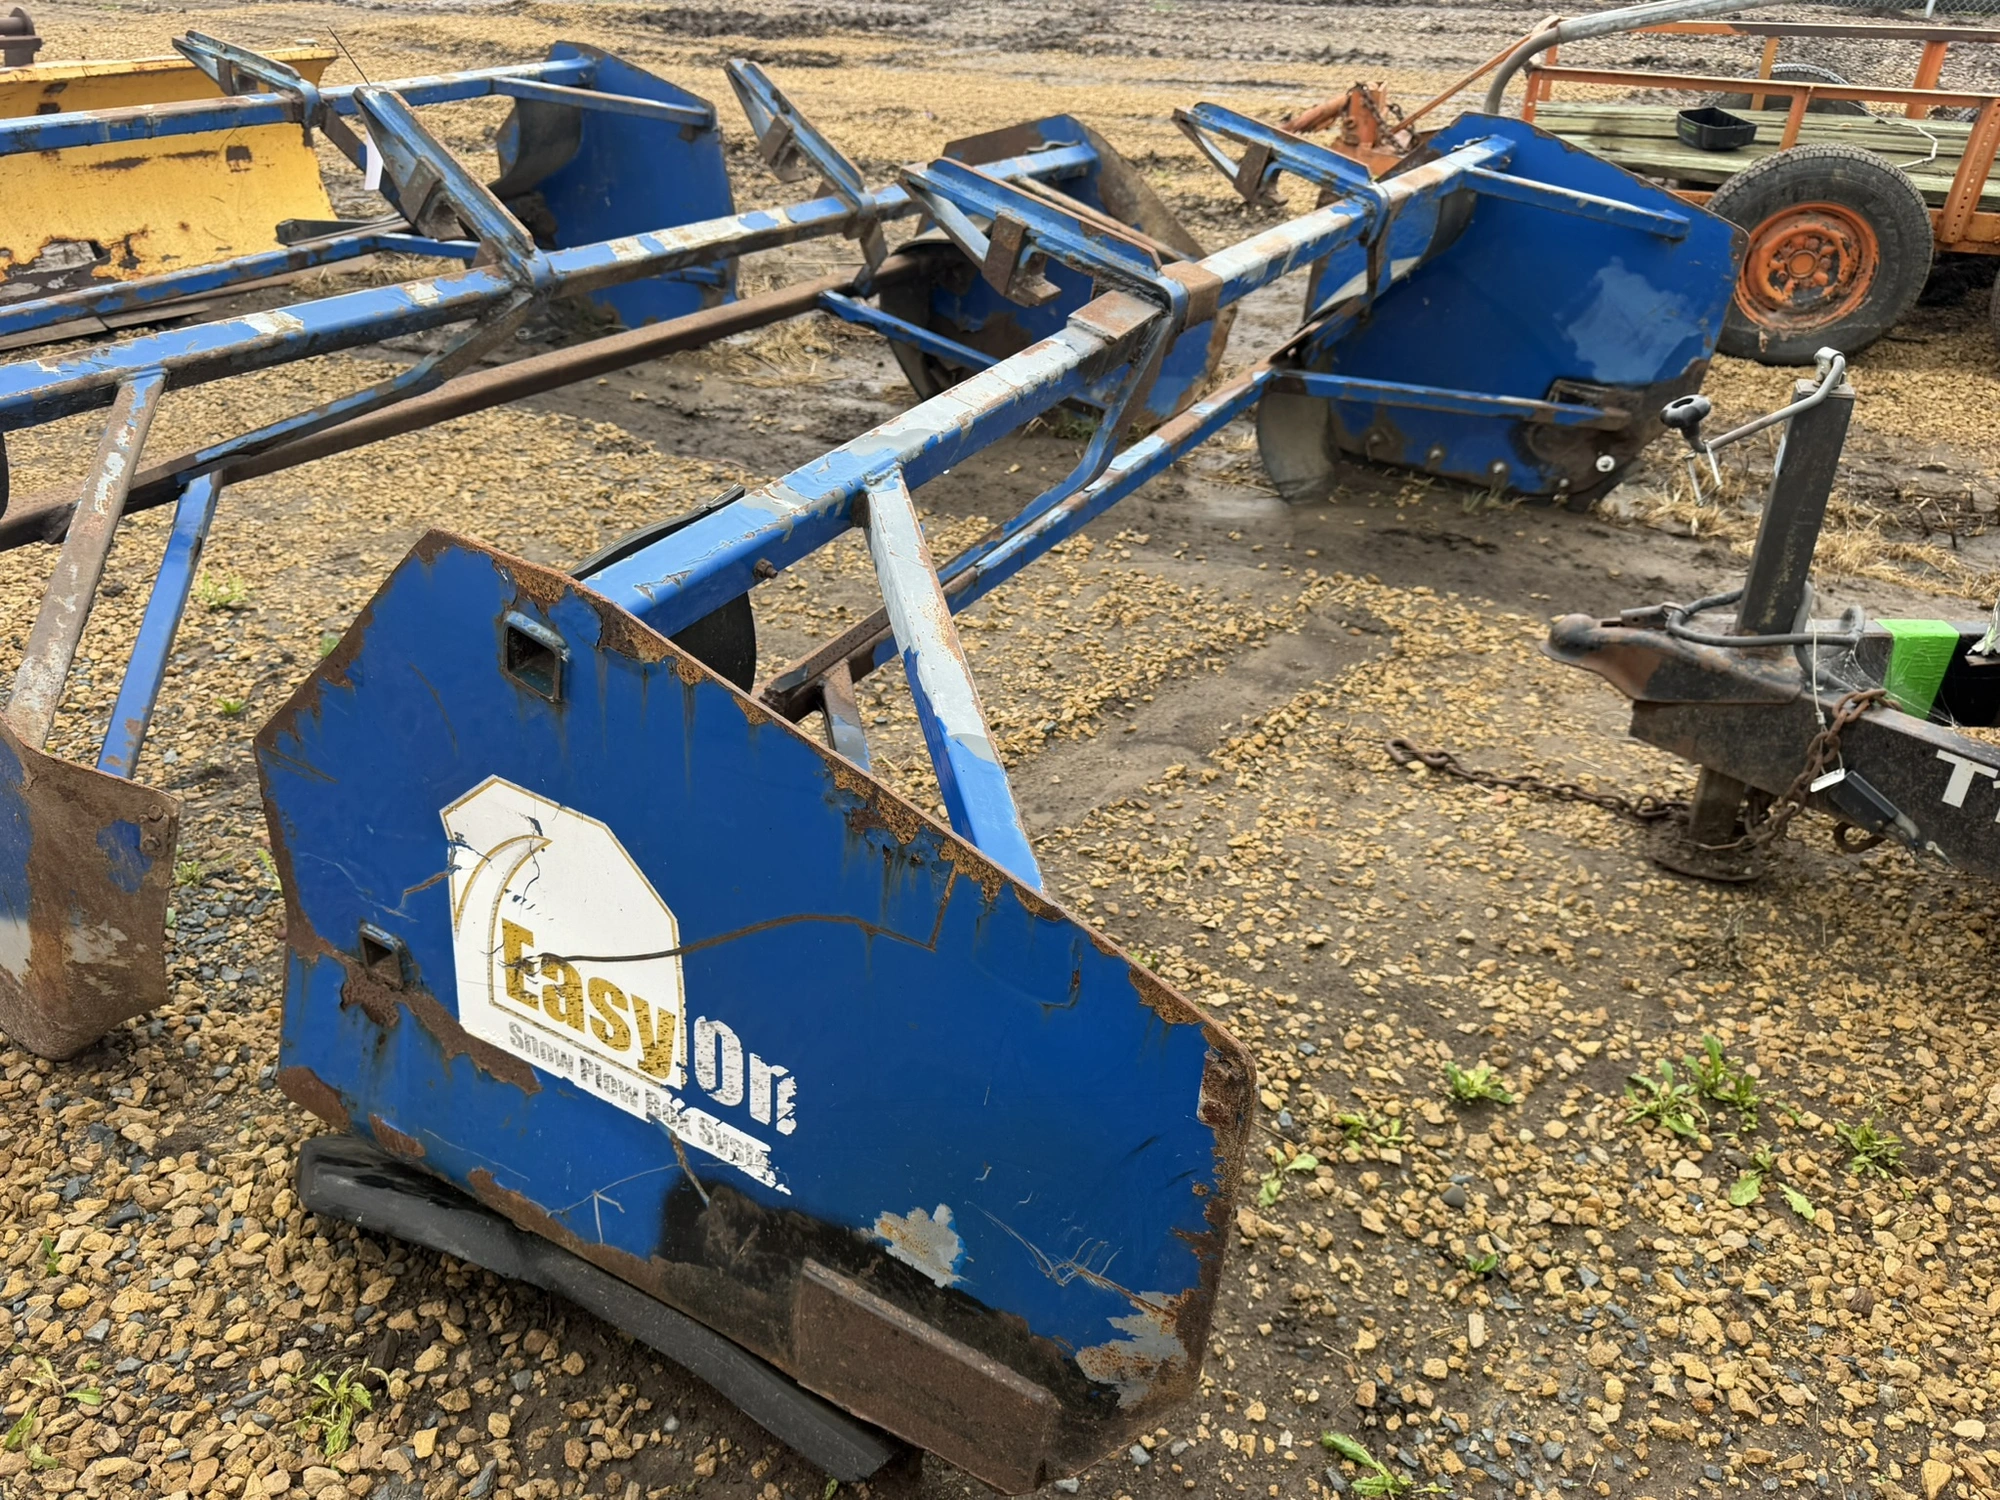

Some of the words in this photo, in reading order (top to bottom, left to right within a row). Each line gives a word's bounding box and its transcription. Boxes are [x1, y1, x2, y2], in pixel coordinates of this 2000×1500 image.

[1936, 749, 2000, 823] T
[501, 917, 677, 1080] Easy
[693, 1015, 798, 1136] On
[509, 1020, 575, 1075] Snow
[580, 1056, 640, 1108] Plow
[644, 1088, 693, 1137] Box
